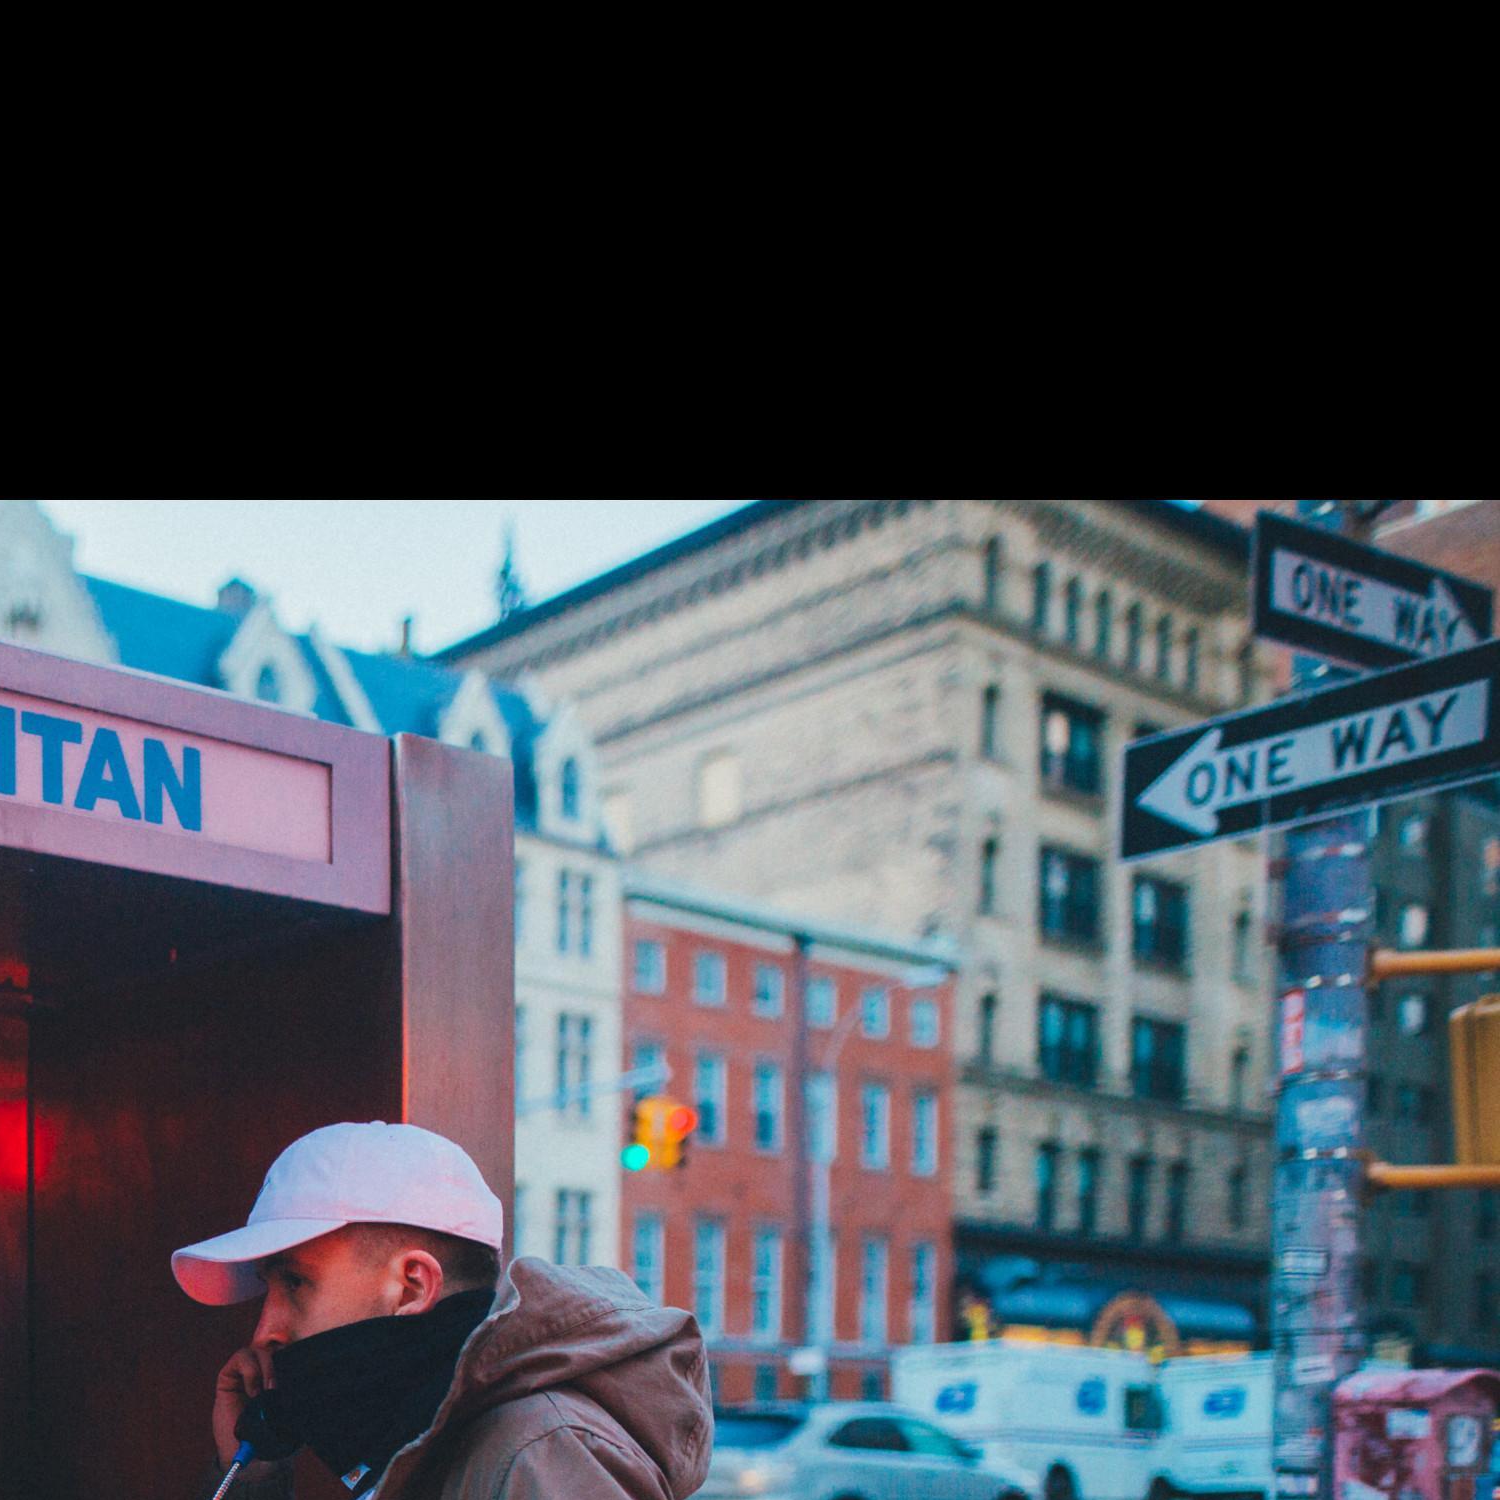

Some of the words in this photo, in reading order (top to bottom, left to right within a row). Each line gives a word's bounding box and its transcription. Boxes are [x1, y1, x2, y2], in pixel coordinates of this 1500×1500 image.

[1291, 564, 1365, 627] ONE
[1393, 594, 1463, 653] WAY
[1185, 739, 1295, 808] ONE
[1331, 693, 1461, 771] WAY
